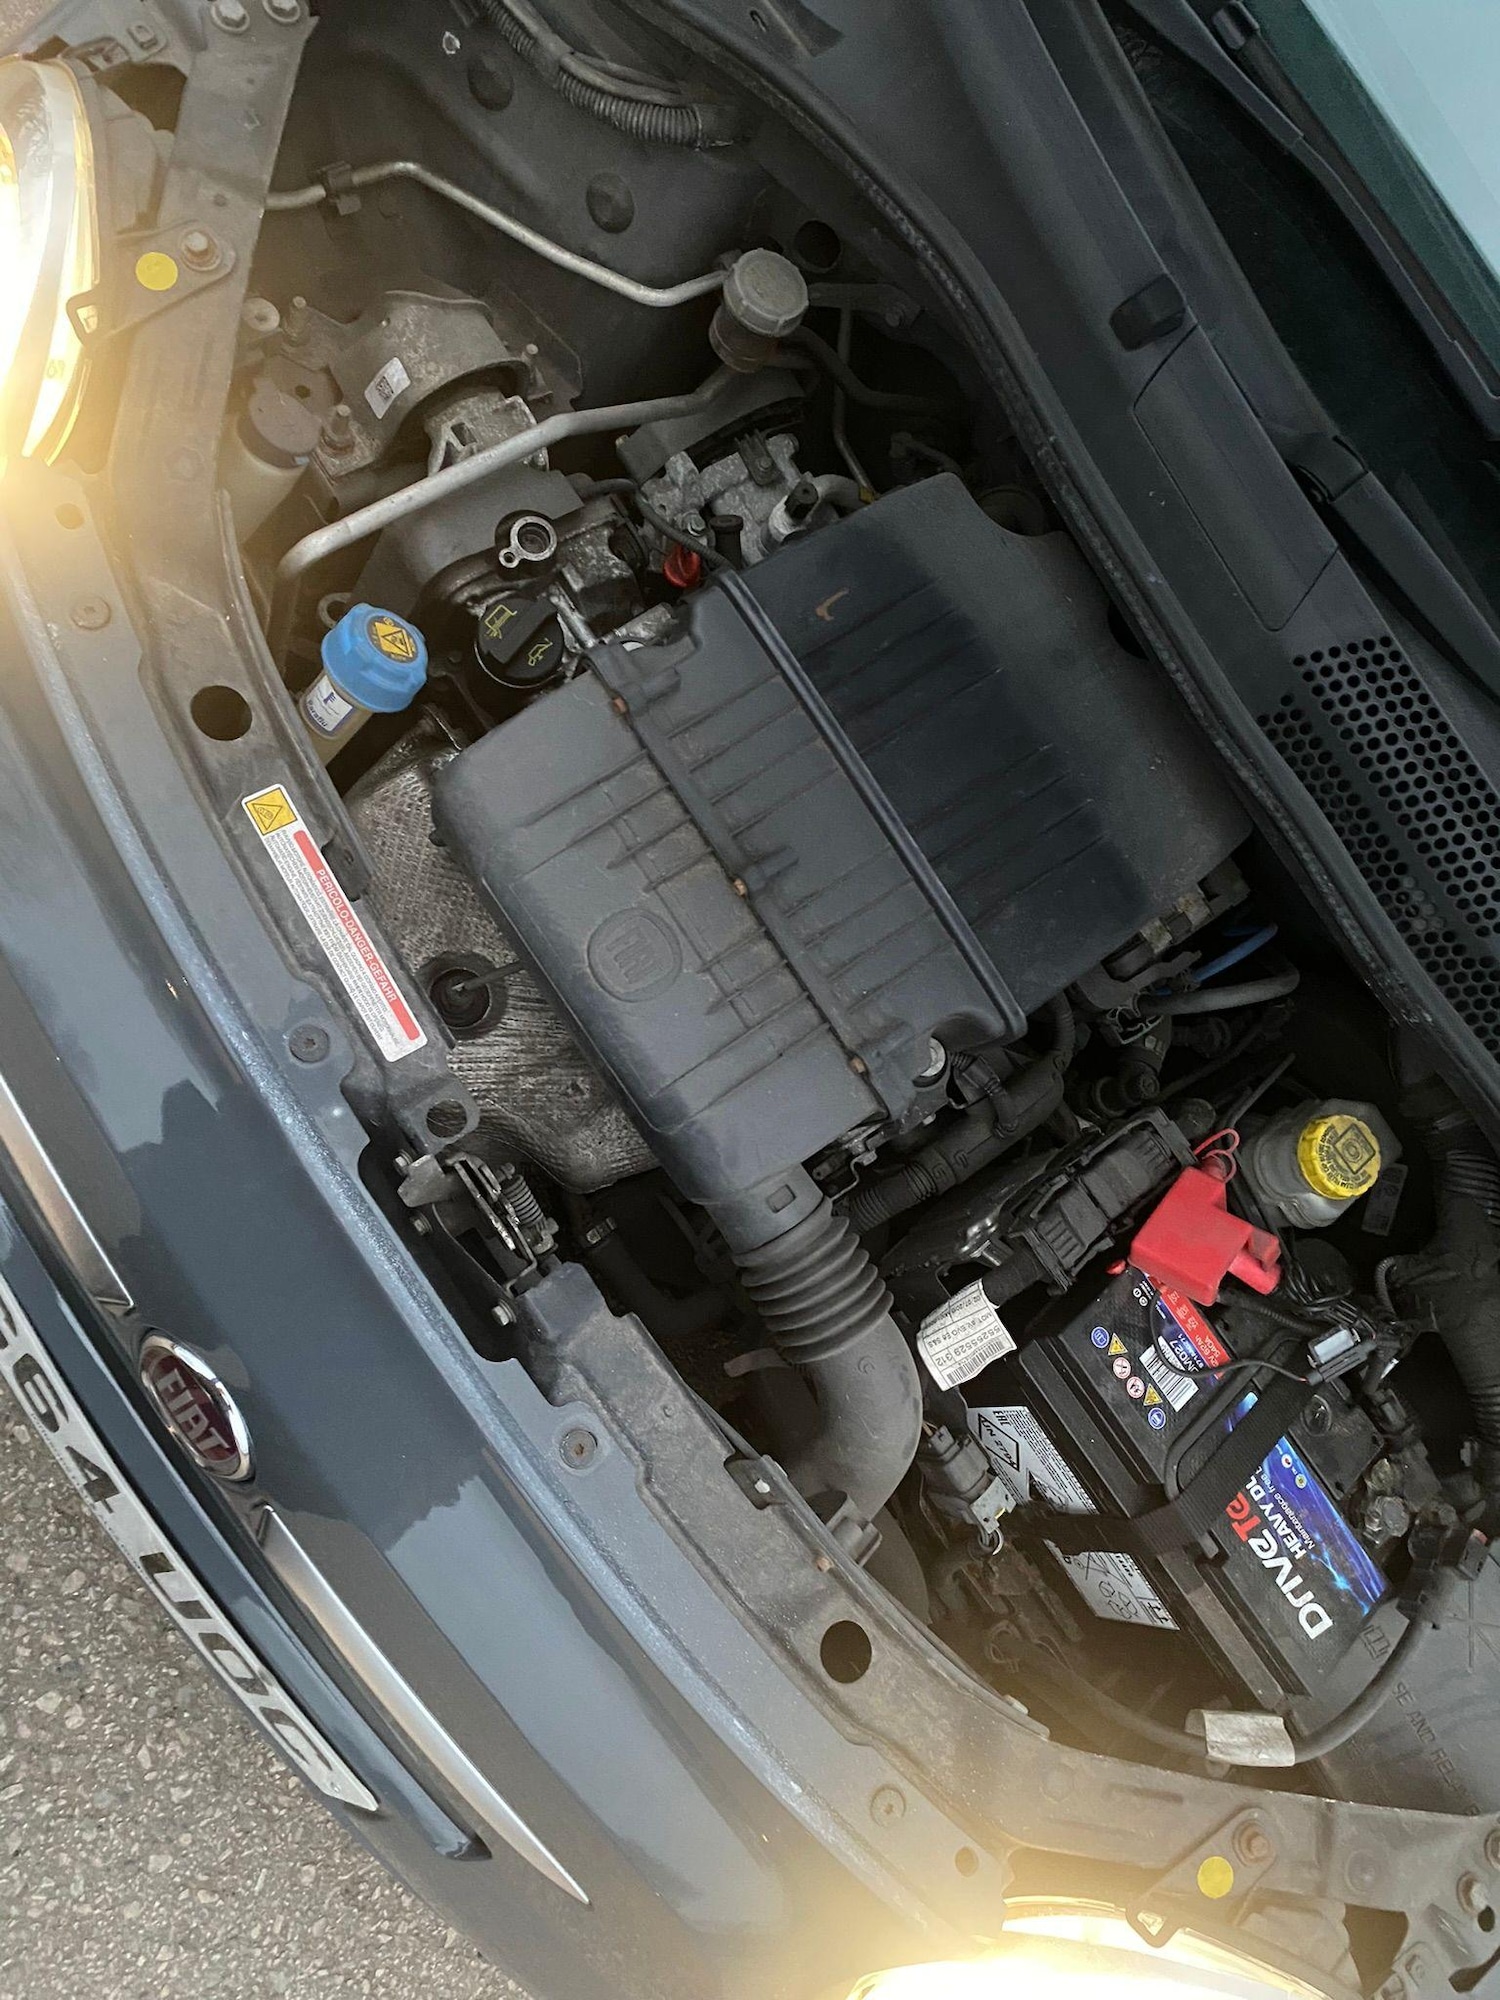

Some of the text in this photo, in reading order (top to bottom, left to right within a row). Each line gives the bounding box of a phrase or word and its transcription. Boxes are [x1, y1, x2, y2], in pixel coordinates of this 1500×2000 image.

[315, 867, 398, 1002] PERICOLO-DANGER-GEFAHR
[935, 1325, 1002, 1367] 55255529 312
[1205, 1335, 1221, 1358] 540A
[155, 1368, 230, 1451] FIAT
[981, 1418, 996, 1437] UN
[995, 1439, 1017, 1468] 2794
[1259, 1503, 1307, 1560] HEAVY
[1261, 1473, 1315, 1550] Maintenance free
[139, 1551, 334, 1773] UOC
[1406, 1710, 1436, 1744] AND
